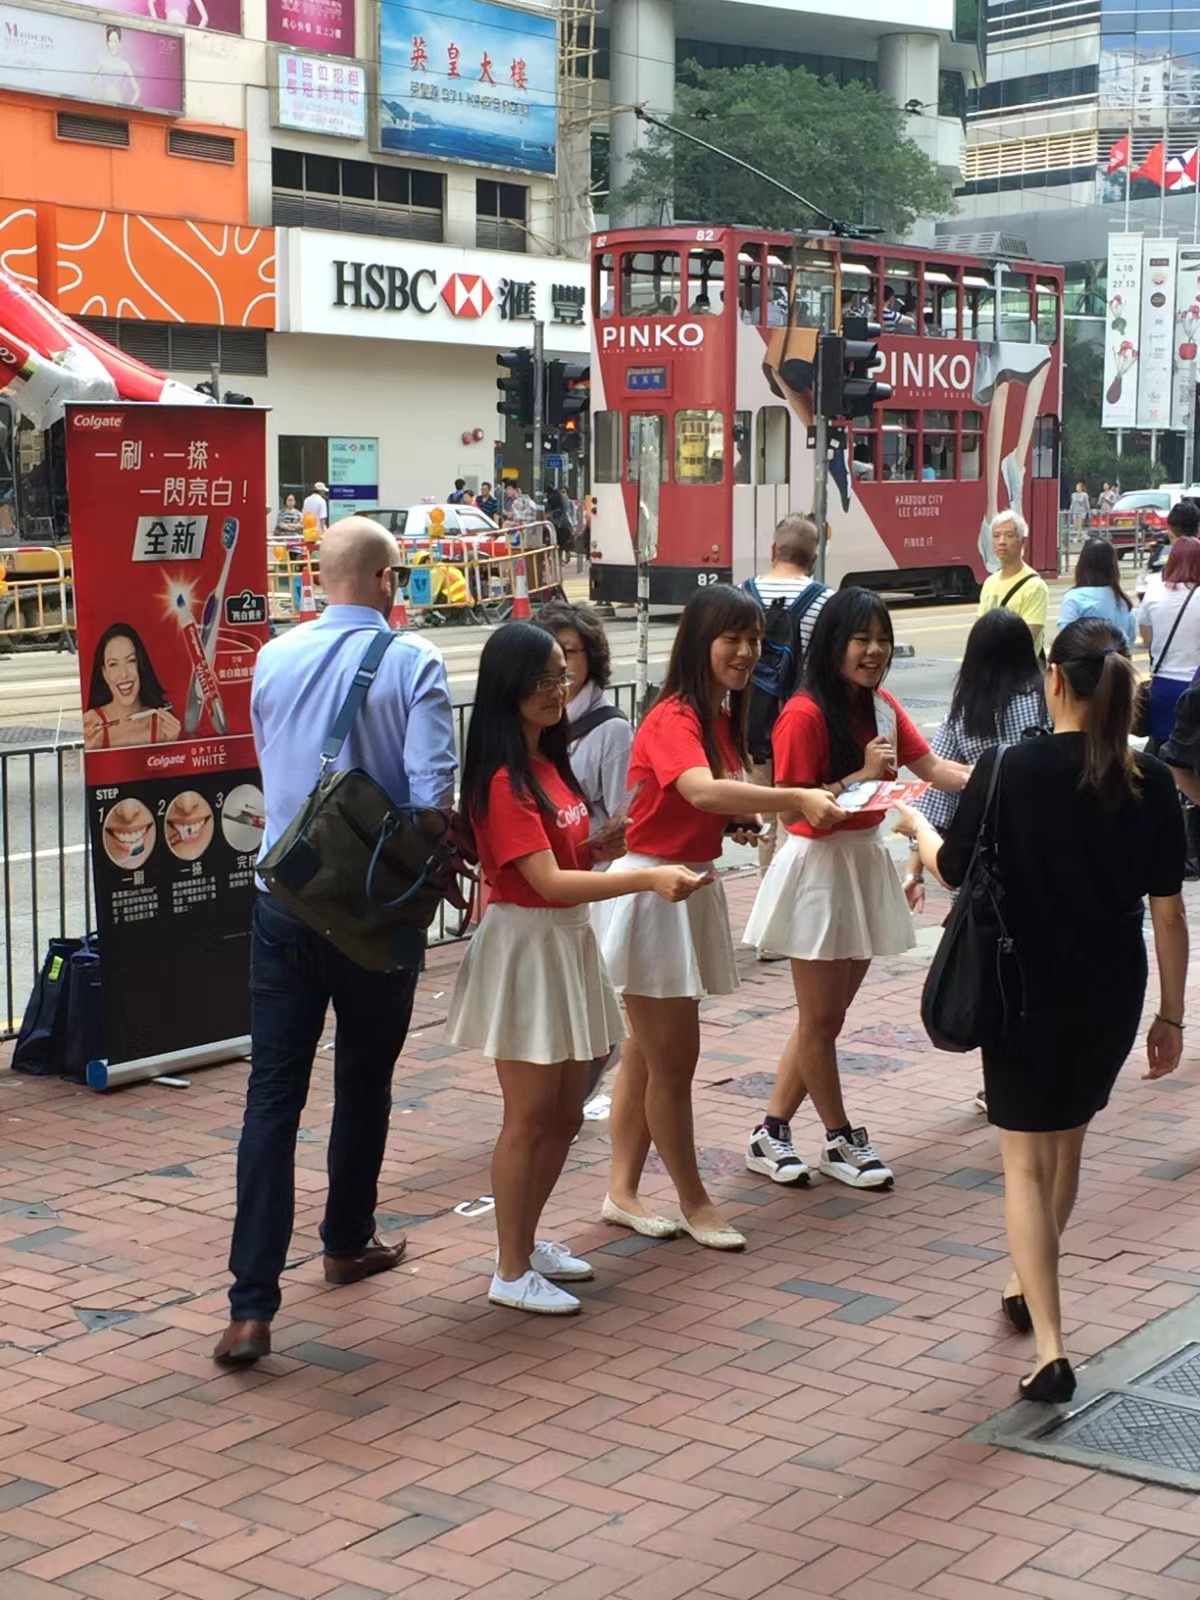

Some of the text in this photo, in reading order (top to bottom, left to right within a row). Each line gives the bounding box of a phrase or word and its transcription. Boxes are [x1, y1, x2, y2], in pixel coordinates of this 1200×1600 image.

[410, 35, 528, 92] 英皇大樓
[596, 235, 607, 248] 82
[696, 230, 714, 241] 82
[333, 260, 437, 314] HSBC
[602, 323, 704, 349] PINKO
[867, 350, 971, 390] PINKO
[73, 415, 122, 430] Colgate
[928, 494, 944, 505] CITY
[898, 506, 940, 517] LEE GARDEN
[143, 521, 197, 555] 全新
[697, 573, 719, 586] 82
[191, 745, 225, 755] OPTIC
[147, 755, 187, 768] Colgate
[192, 753, 227, 767] WHITE
[96, 788, 119, 800] STEP
[215, 792, 224, 808] 3
[157, 800, 166, 815] 2
[98, 807, 105, 823] 1
